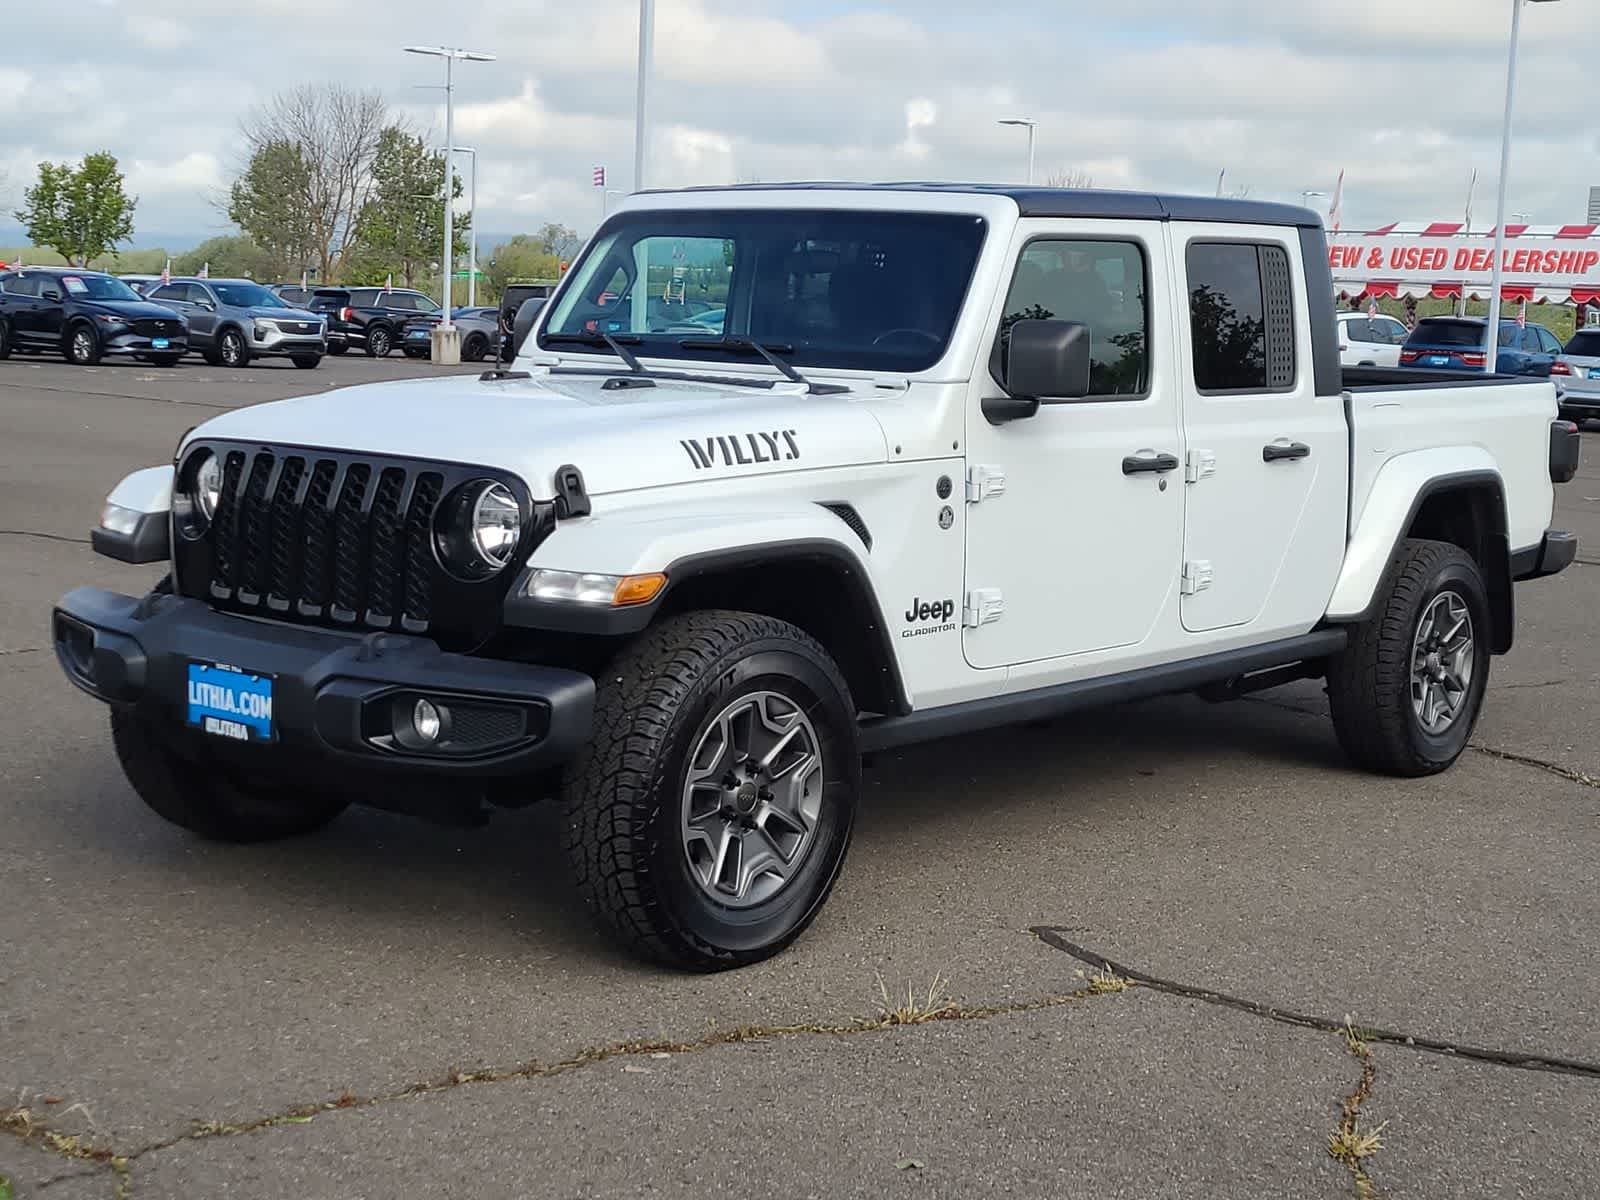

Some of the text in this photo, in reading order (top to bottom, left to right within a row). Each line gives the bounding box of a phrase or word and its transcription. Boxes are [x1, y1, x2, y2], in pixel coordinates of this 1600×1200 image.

[1328, 245, 1599, 274] EW & USED DEALERSHIP
[679, 429, 800, 469] WILLYS
[905, 597, 954, 623] Jeep
[901, 623, 956, 639] GLADIATOR
[188, 680, 272, 720] LITHIA.COM
